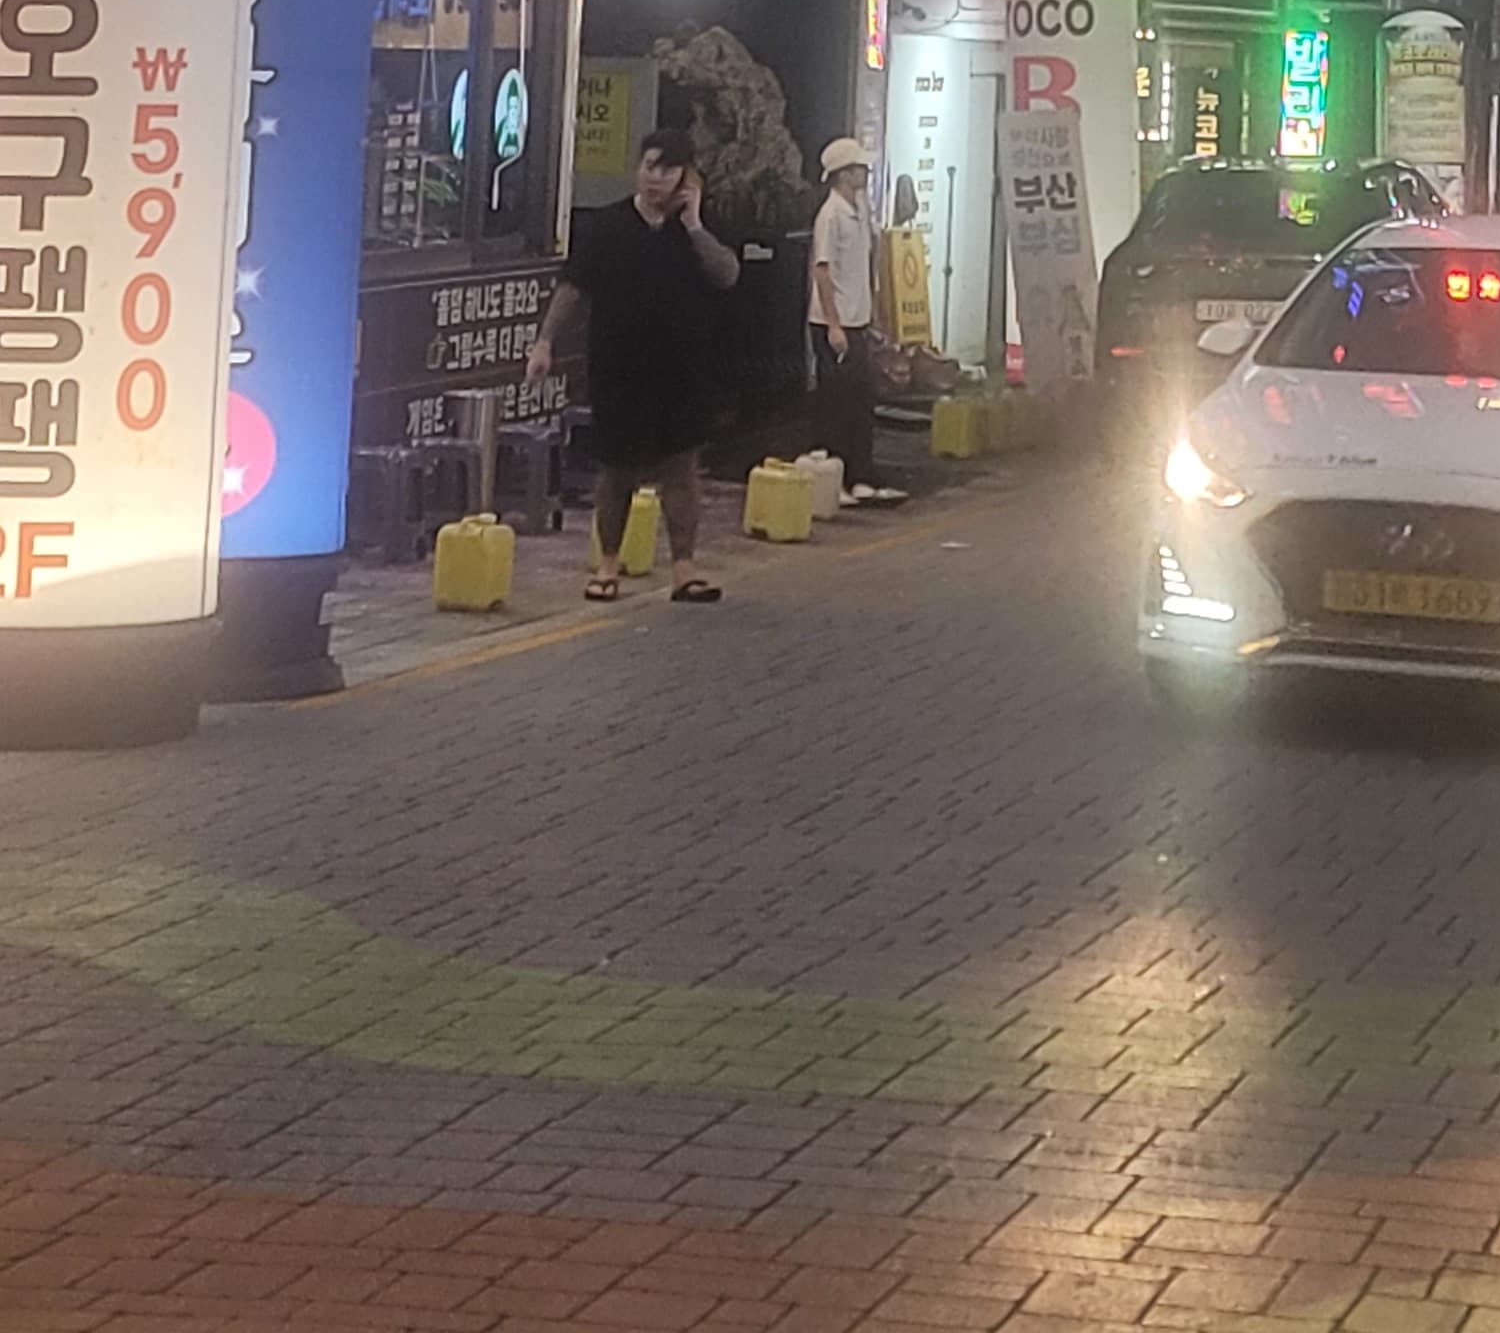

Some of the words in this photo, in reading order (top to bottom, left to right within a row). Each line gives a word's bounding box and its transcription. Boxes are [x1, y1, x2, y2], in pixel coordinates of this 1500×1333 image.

[1012, 172, 1078, 214] 부산
[464, 284, 501, 322] 하나도
[0, 520, 76, 599] F
